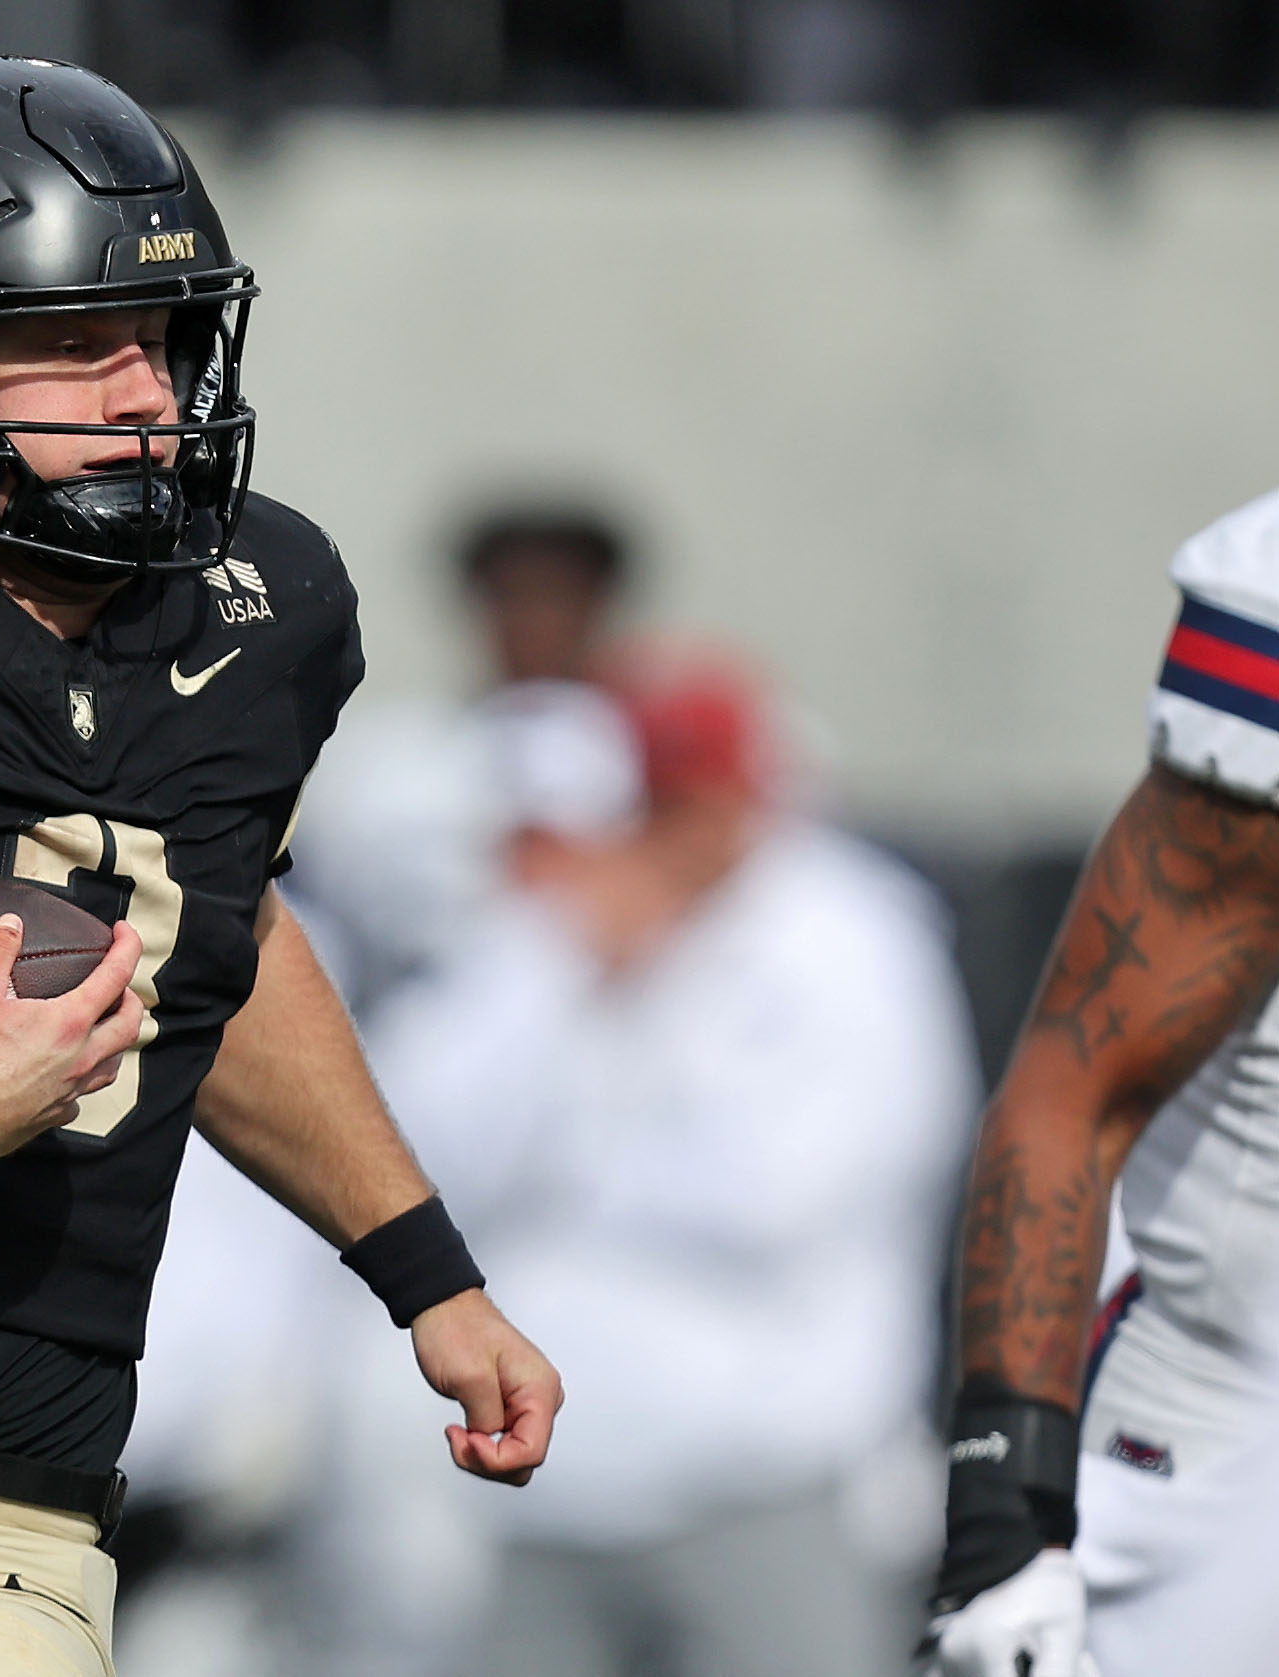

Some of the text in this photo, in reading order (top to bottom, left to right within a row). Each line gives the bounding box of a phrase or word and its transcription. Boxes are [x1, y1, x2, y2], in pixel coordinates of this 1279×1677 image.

[138, 232, 195, 264] ARMY
[217, 595, 274, 624] USAA
[13, 813, 184, 1138] 3
